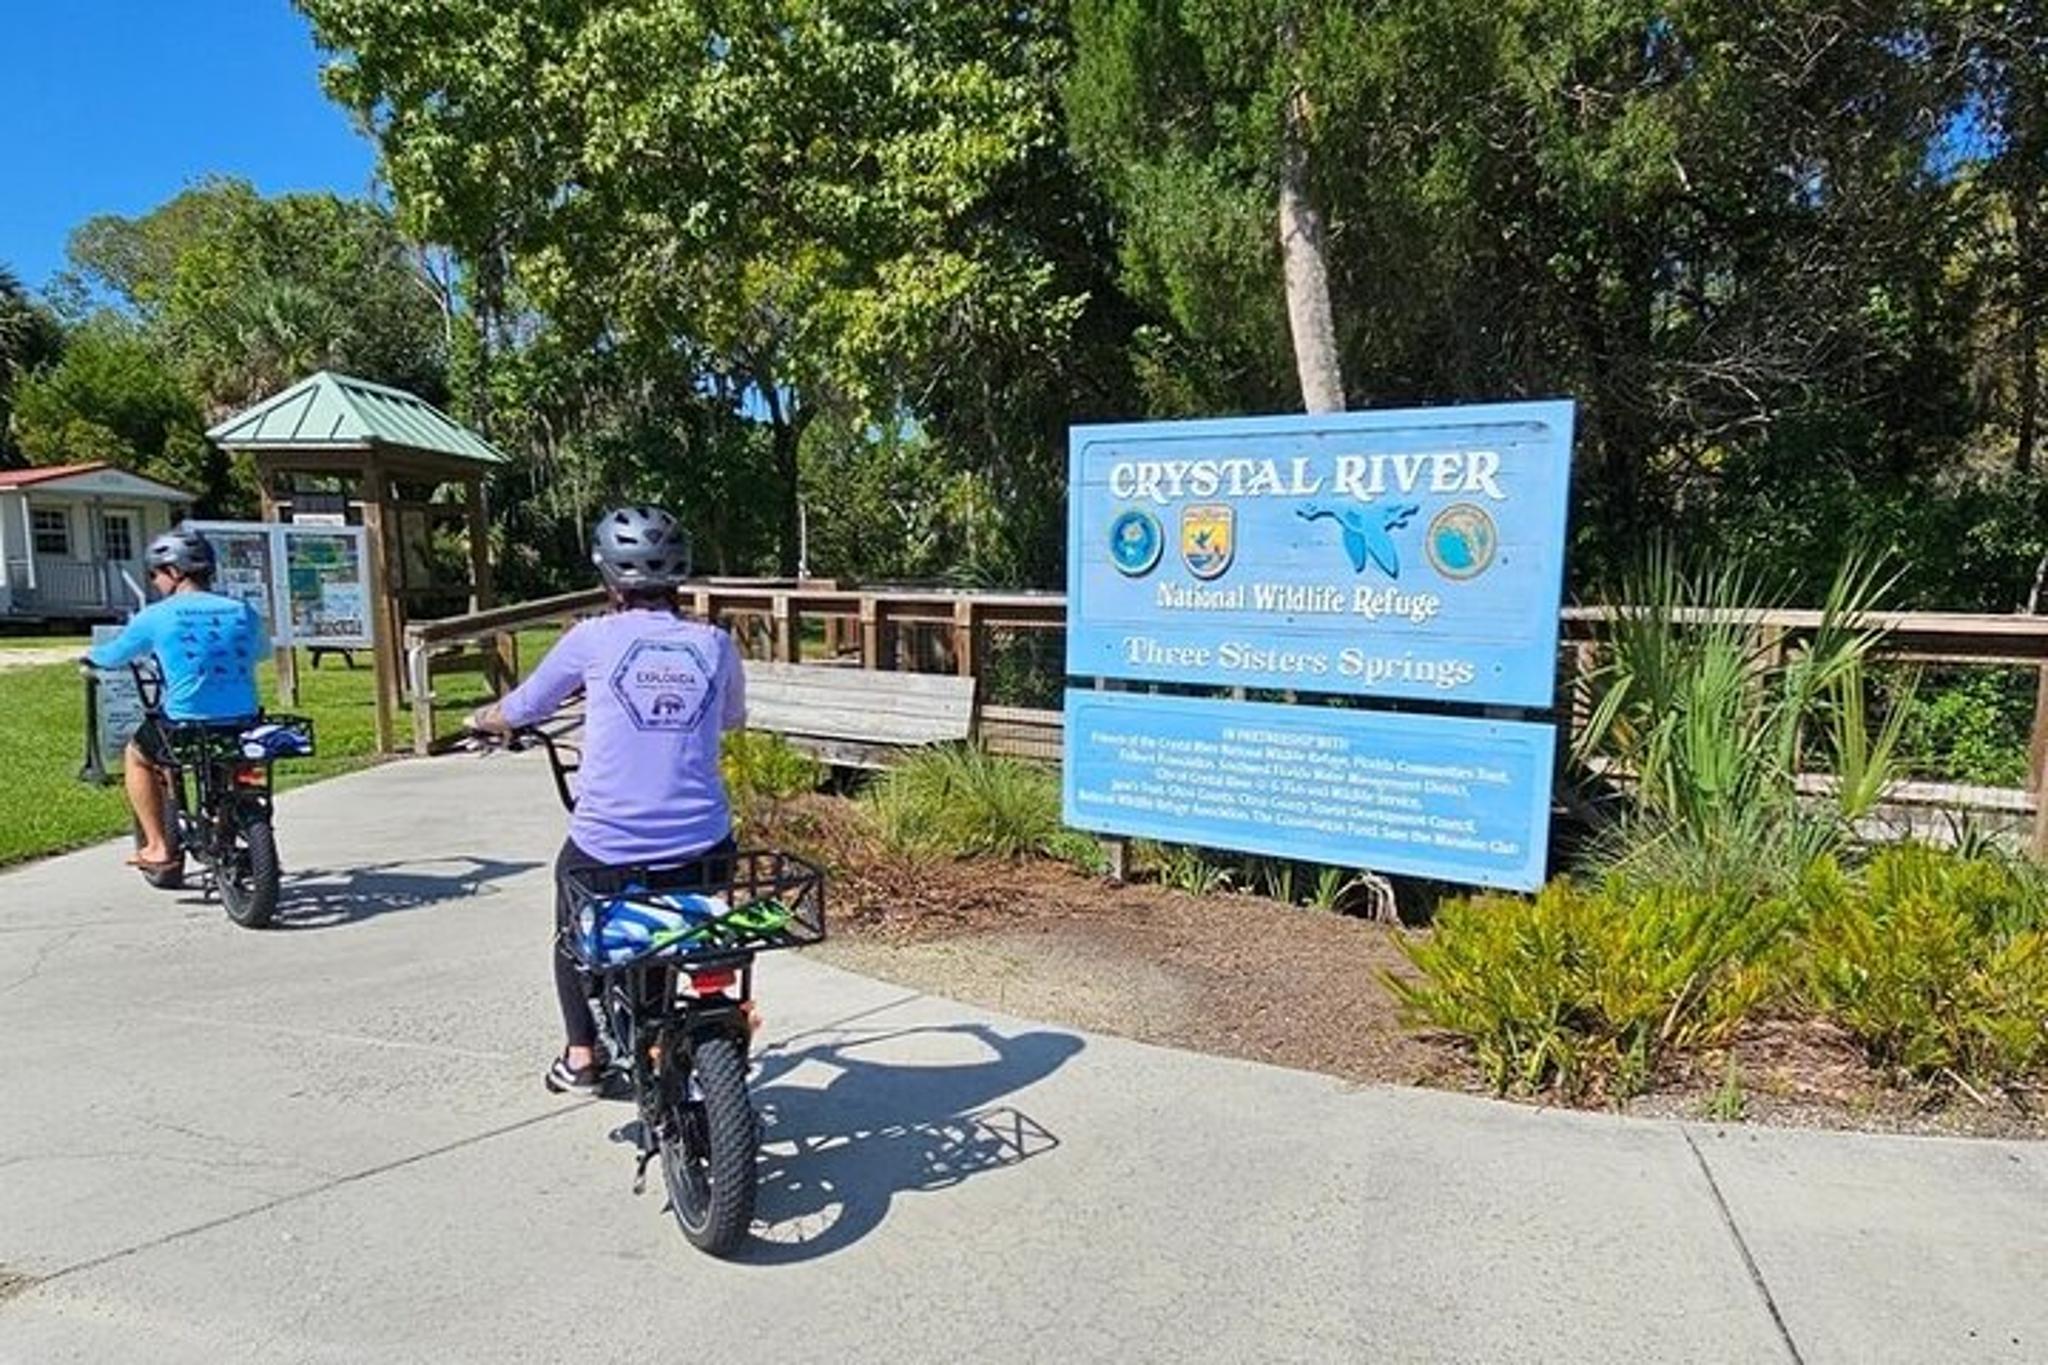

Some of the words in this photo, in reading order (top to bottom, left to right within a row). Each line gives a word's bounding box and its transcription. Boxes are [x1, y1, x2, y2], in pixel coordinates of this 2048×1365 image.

[1109, 457, 1324, 505] CRYSTAL
[1334, 450, 1507, 502] RIVER
[1156, 581, 1244, 614] National
[1253, 584, 1344, 616] Wildlife
[1352, 587, 1440, 624] Refuge
[1124, 636, 1209, 668] Three
[1218, 640, 1328, 677] Sisters
[1337, 645, 1476, 690] Springs
